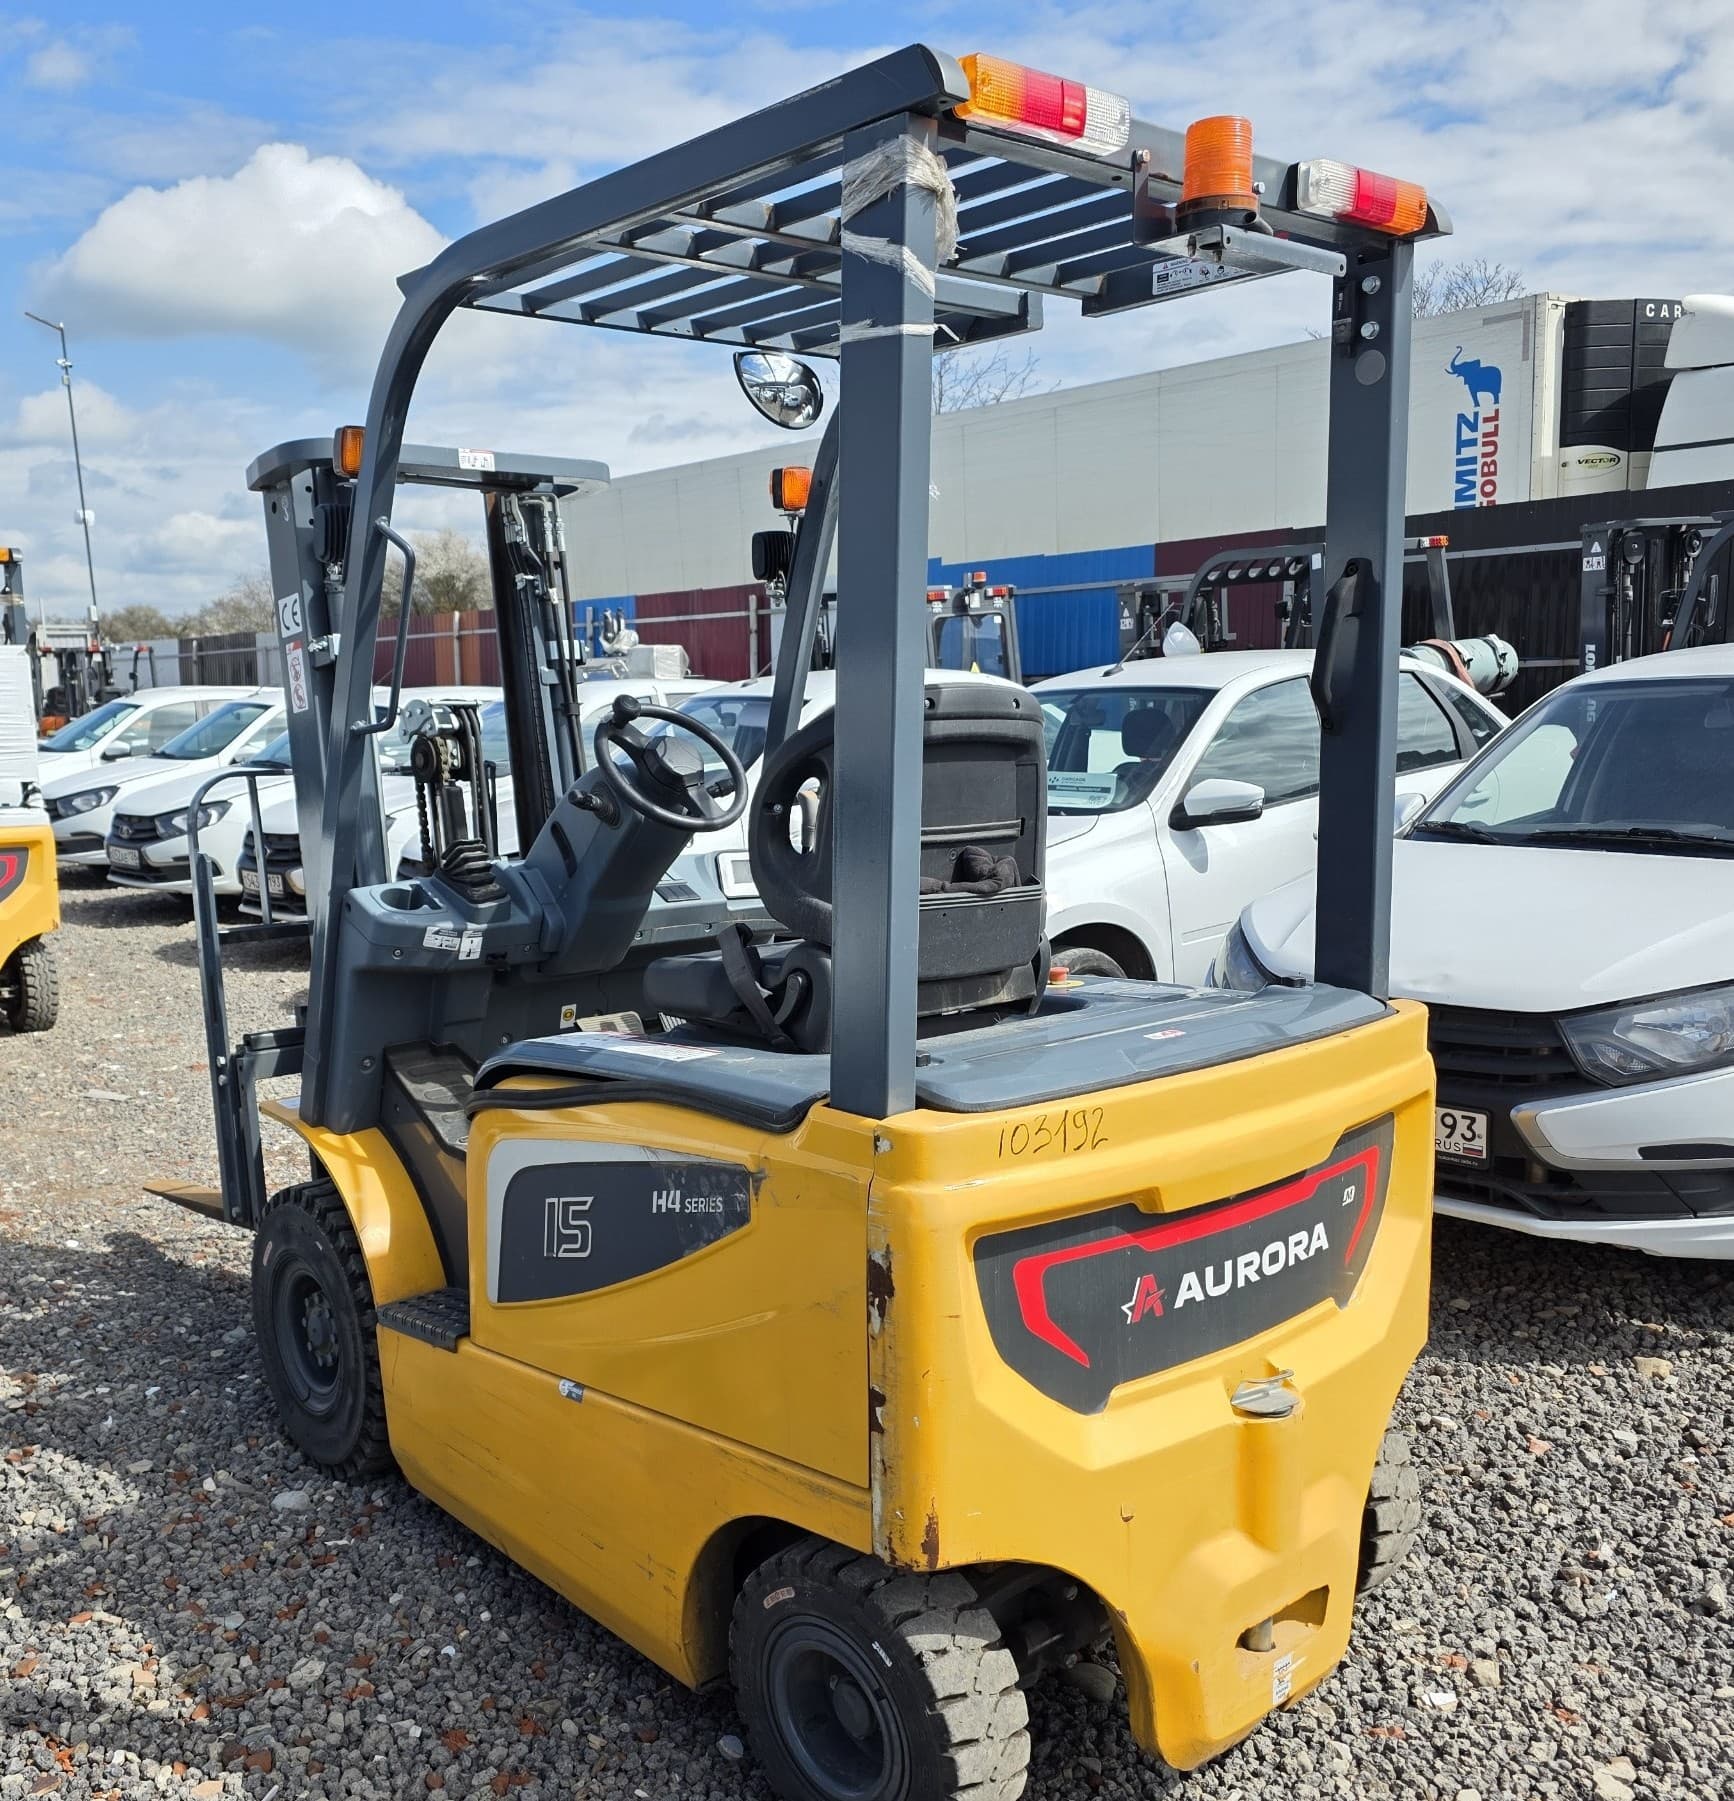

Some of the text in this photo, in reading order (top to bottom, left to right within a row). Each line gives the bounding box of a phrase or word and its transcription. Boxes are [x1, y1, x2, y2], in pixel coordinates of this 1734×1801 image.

[1577, 456, 1617, 465] VECTOR
[652, 1190, 723, 1214] H4 SERIES
[544, 1196, 594, 1258] 15
[1173, 1222, 1329, 1309] AURORA
